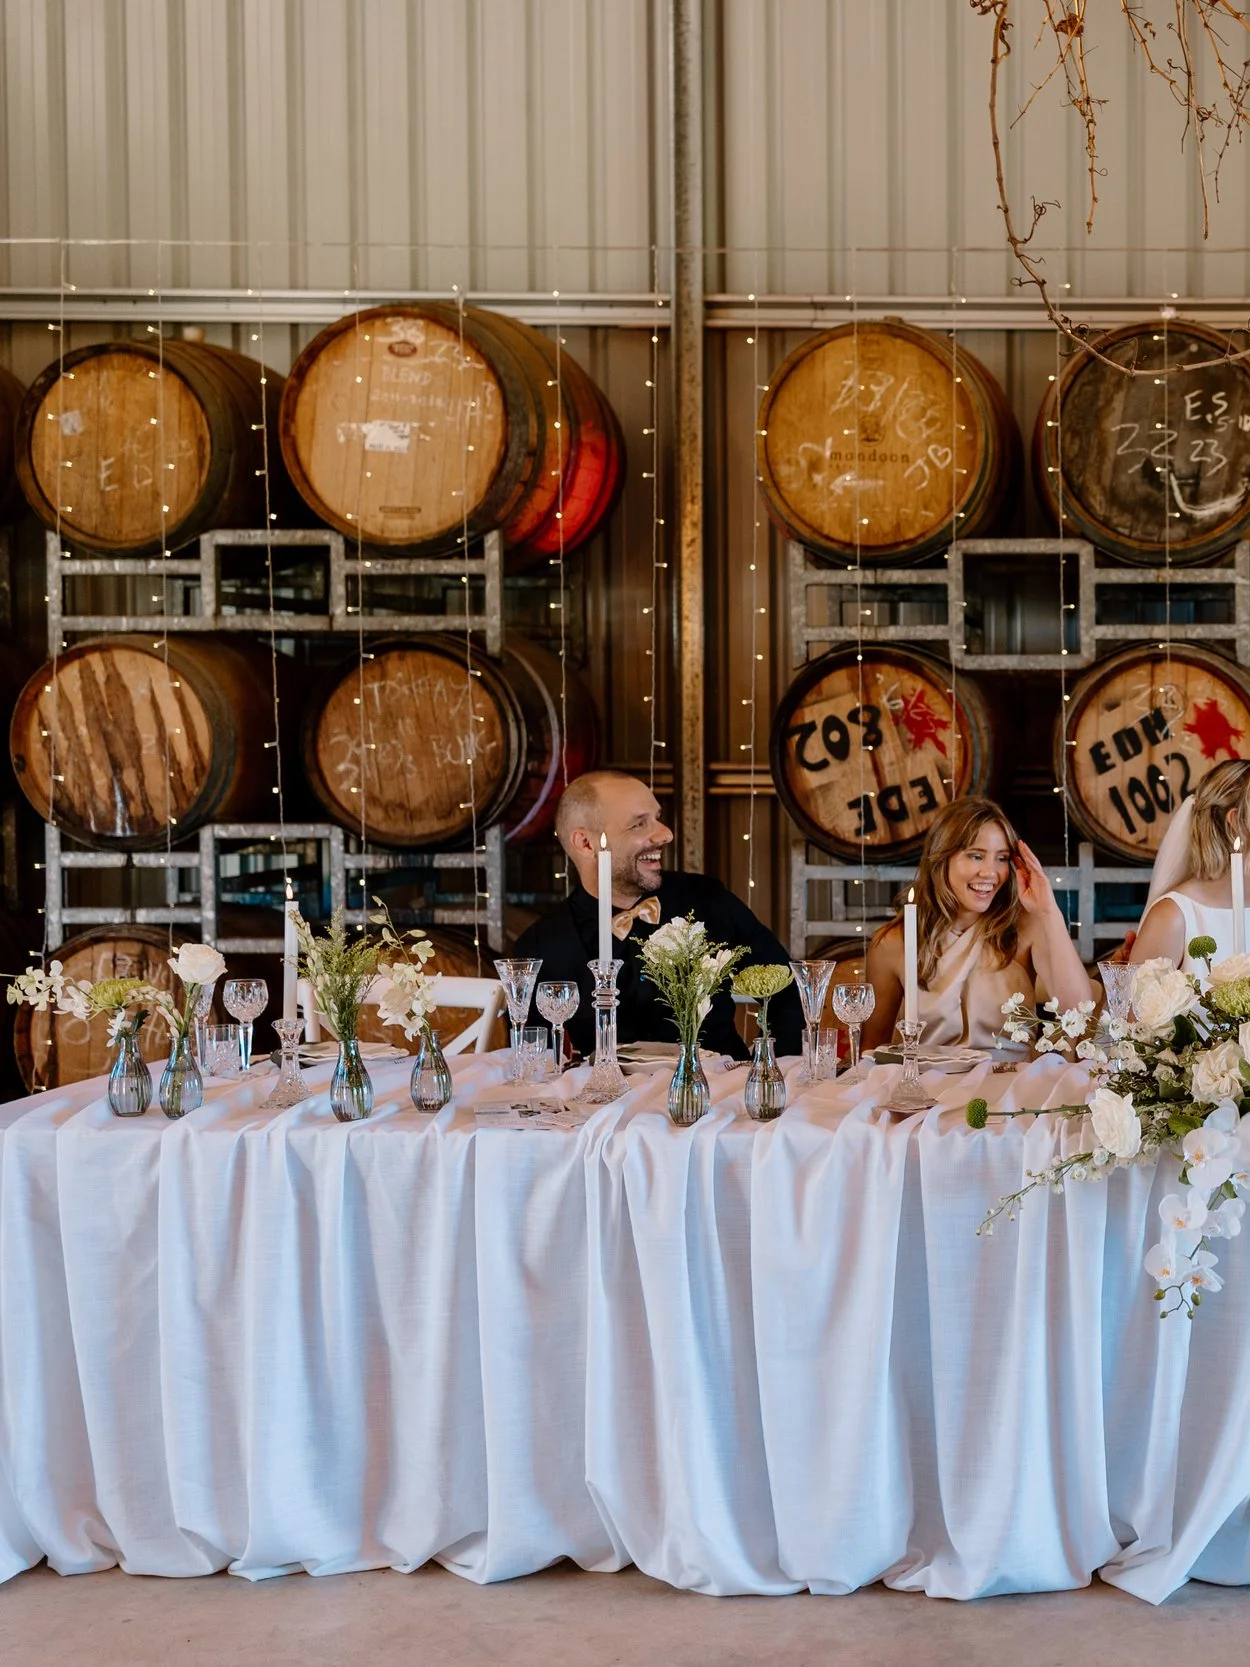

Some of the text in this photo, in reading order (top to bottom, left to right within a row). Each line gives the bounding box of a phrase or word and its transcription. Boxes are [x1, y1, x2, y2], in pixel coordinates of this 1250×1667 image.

[830, 448, 909, 464] mandoon
[787, 705, 883, 772] 802
[1089, 707, 1173, 776] EDH
[847, 776, 938, 837] EDE
[1109, 753, 1197, 835] 1002
